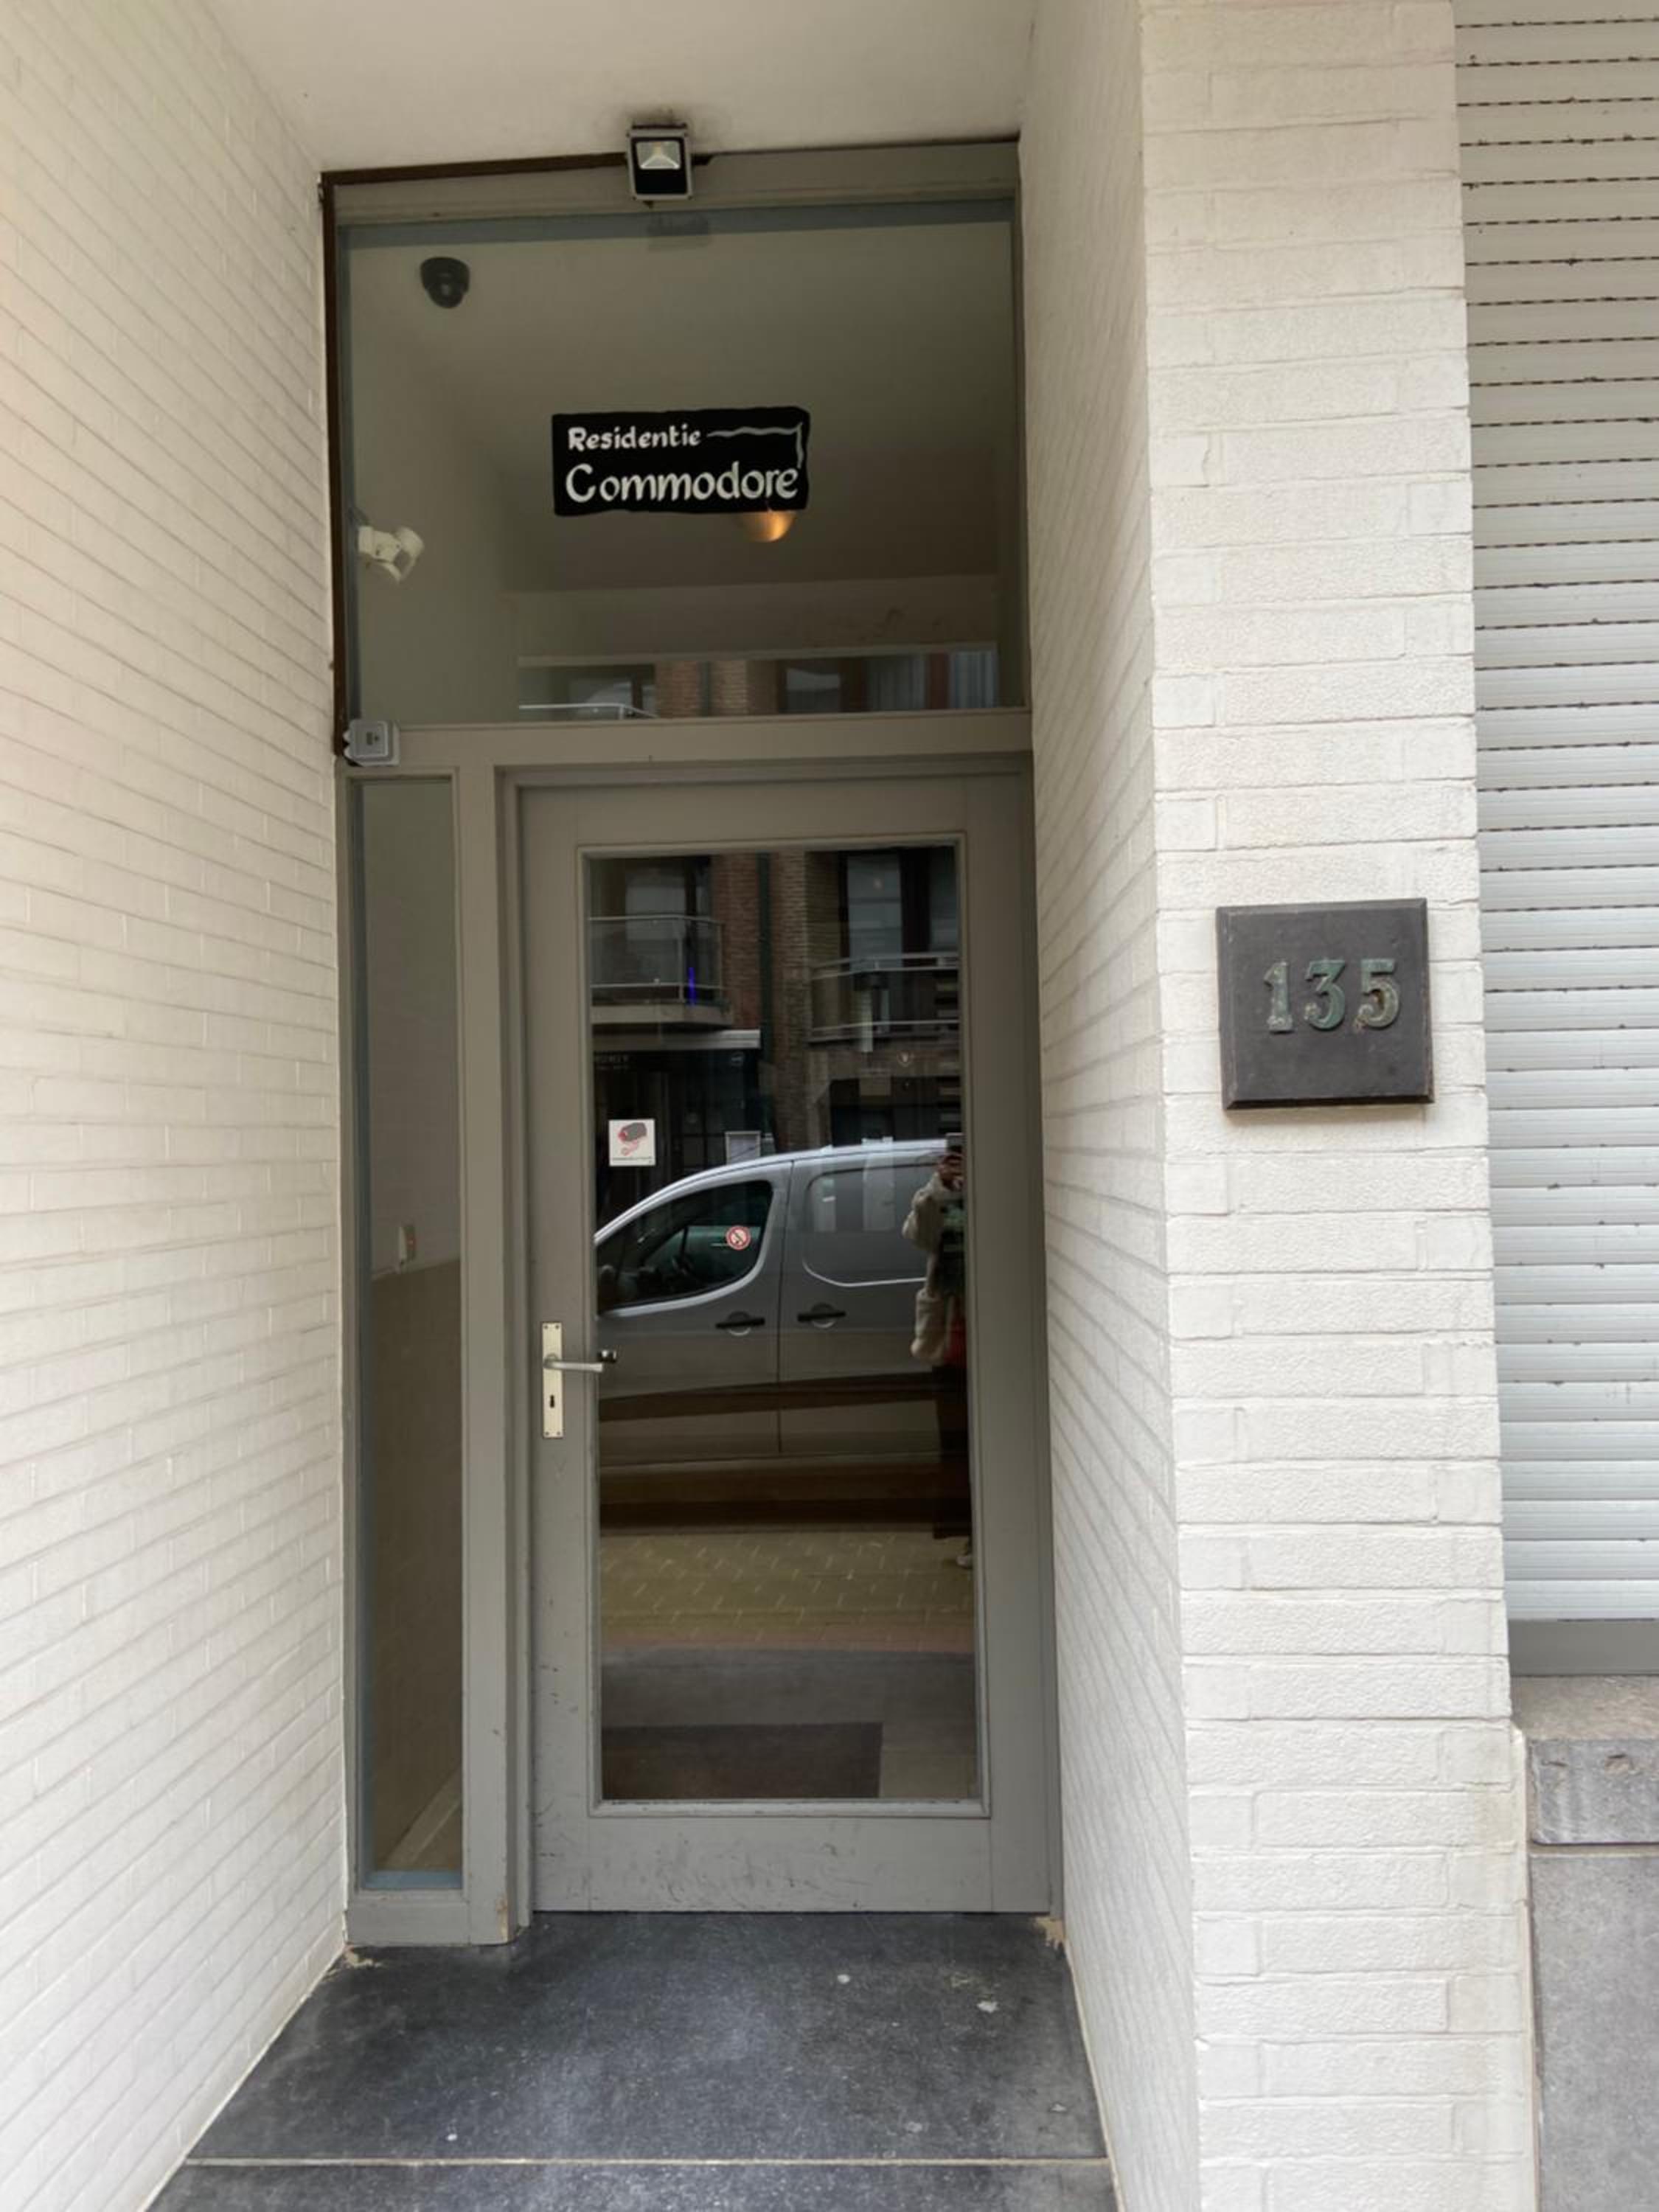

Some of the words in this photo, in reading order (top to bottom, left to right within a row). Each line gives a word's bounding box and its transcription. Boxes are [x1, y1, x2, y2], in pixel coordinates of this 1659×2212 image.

[568, 422, 701, 451] Residentie
[566, 461, 799, 502] Commodore
[1264, 959, 1399, 1032] 135
